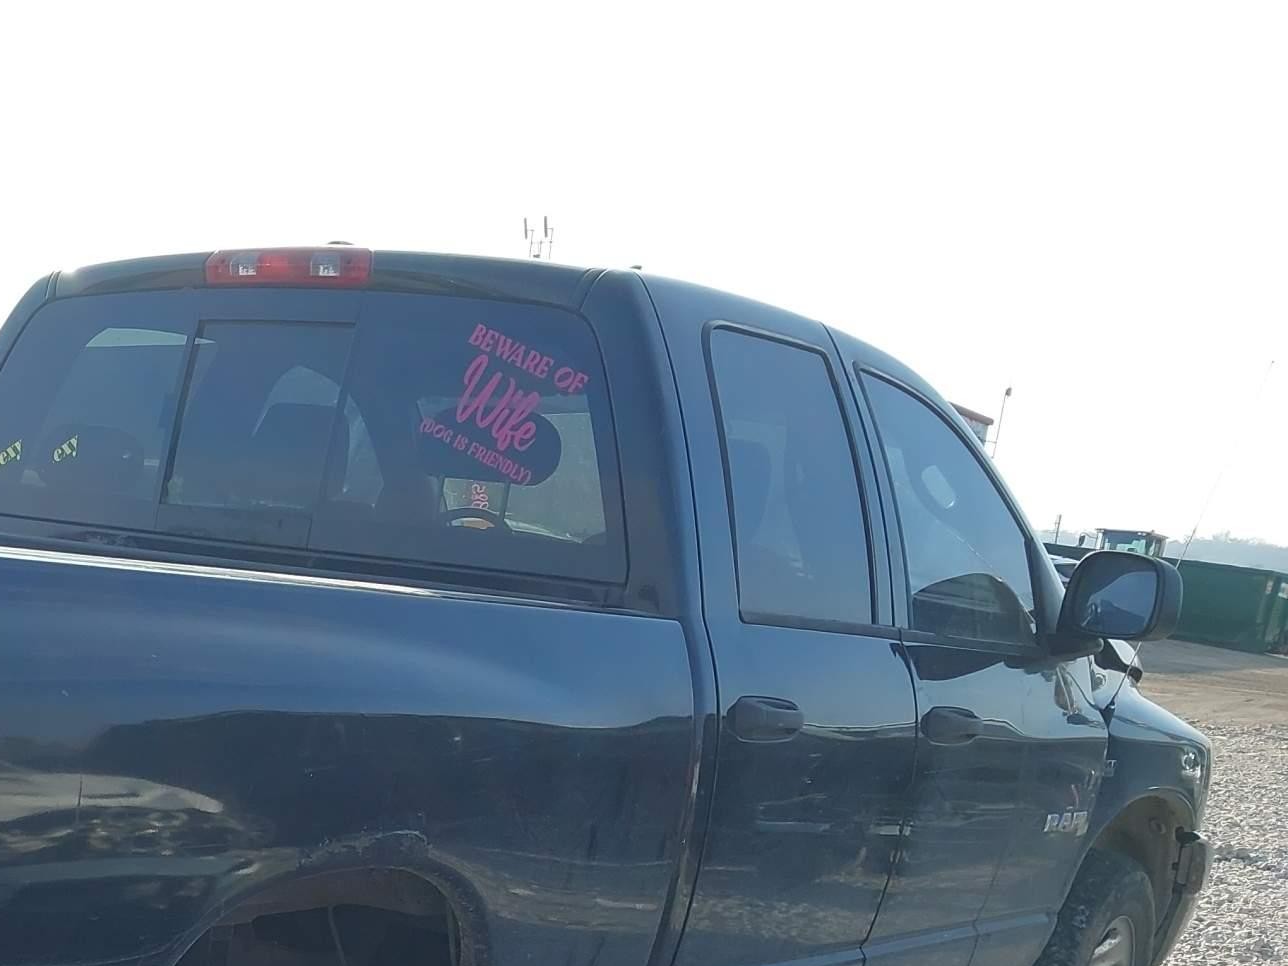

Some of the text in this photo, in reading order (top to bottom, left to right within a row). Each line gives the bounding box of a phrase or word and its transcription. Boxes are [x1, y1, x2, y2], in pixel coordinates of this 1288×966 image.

[468, 323, 590, 393] BEWARE OF
[456, 354, 541, 452] Wife
[52, 434, 78, 463] exy
[420, 417, 533, 486] (DOG IS FRIENDLY)
